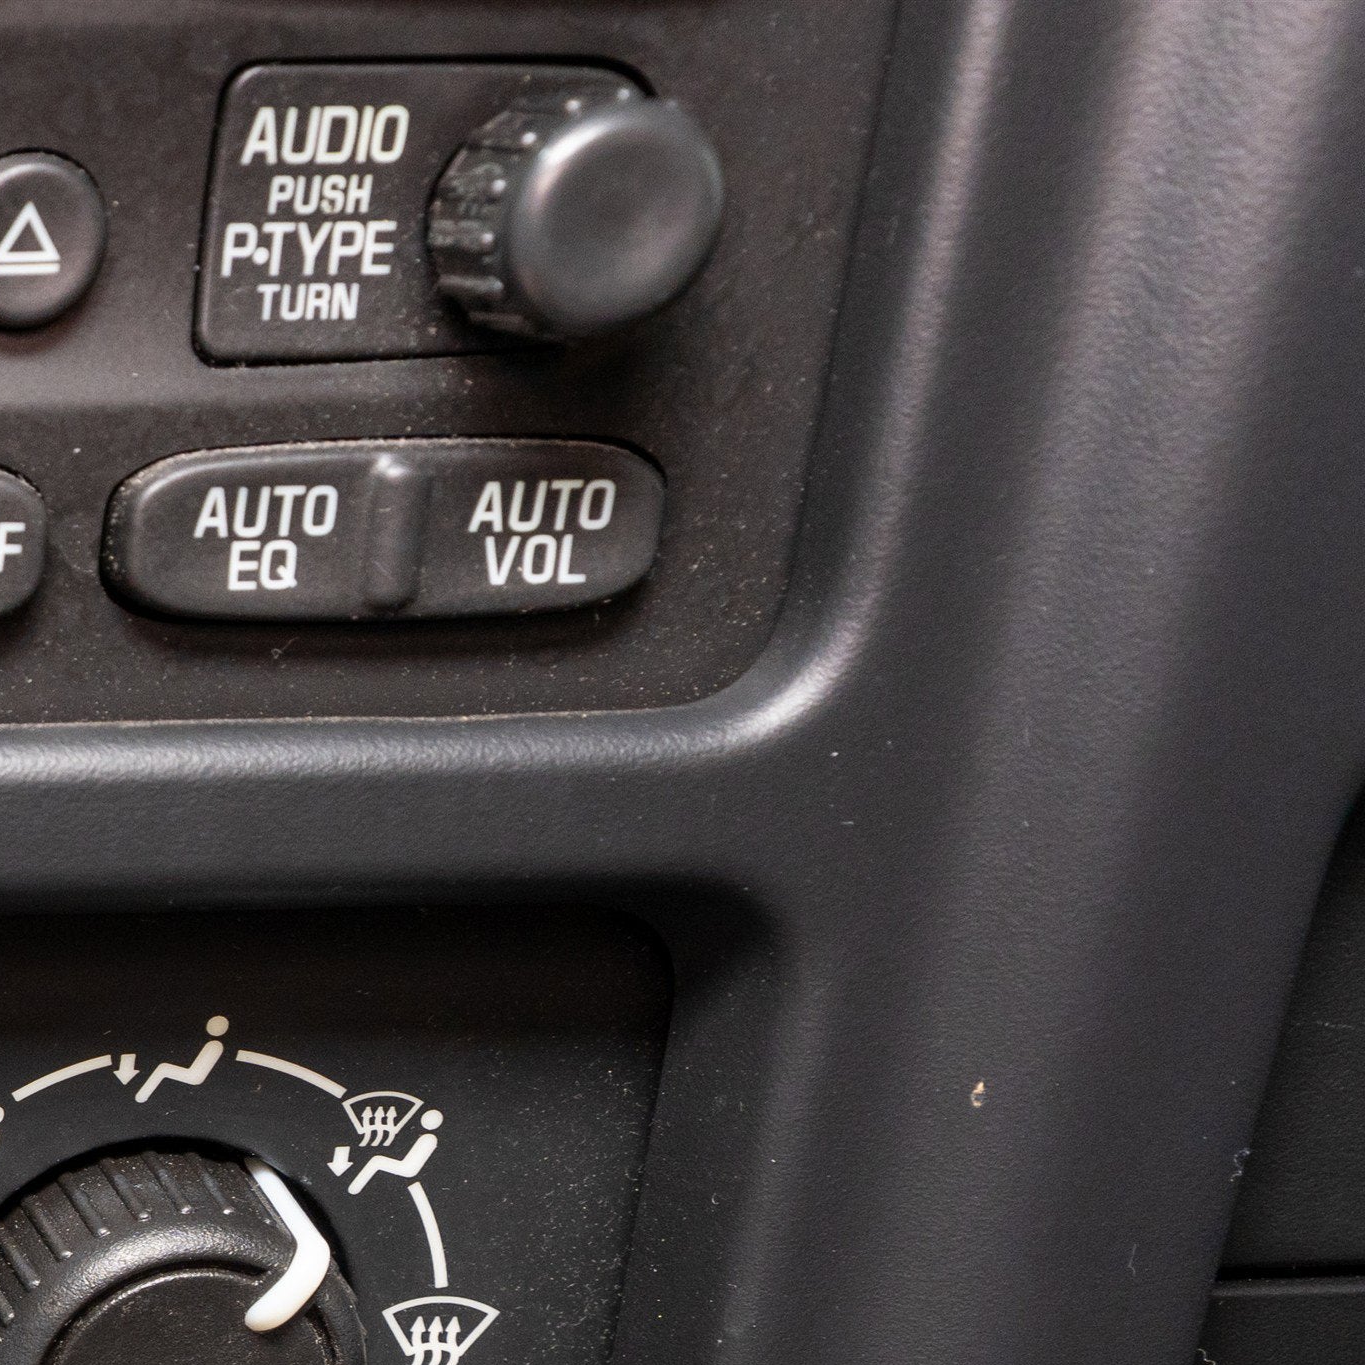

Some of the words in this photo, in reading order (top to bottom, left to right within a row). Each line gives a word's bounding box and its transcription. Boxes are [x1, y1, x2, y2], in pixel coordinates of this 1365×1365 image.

[241, 105, 409, 164] AUDIO
[268, 174, 372, 214] PUSH
[257, 282, 359, 321] TURN
[193, 484, 339, 538] AUTO
[467, 479, 616, 533] AUTO
[226, 539, 298, 591] EQ
[484, 533, 586, 586] VOL
